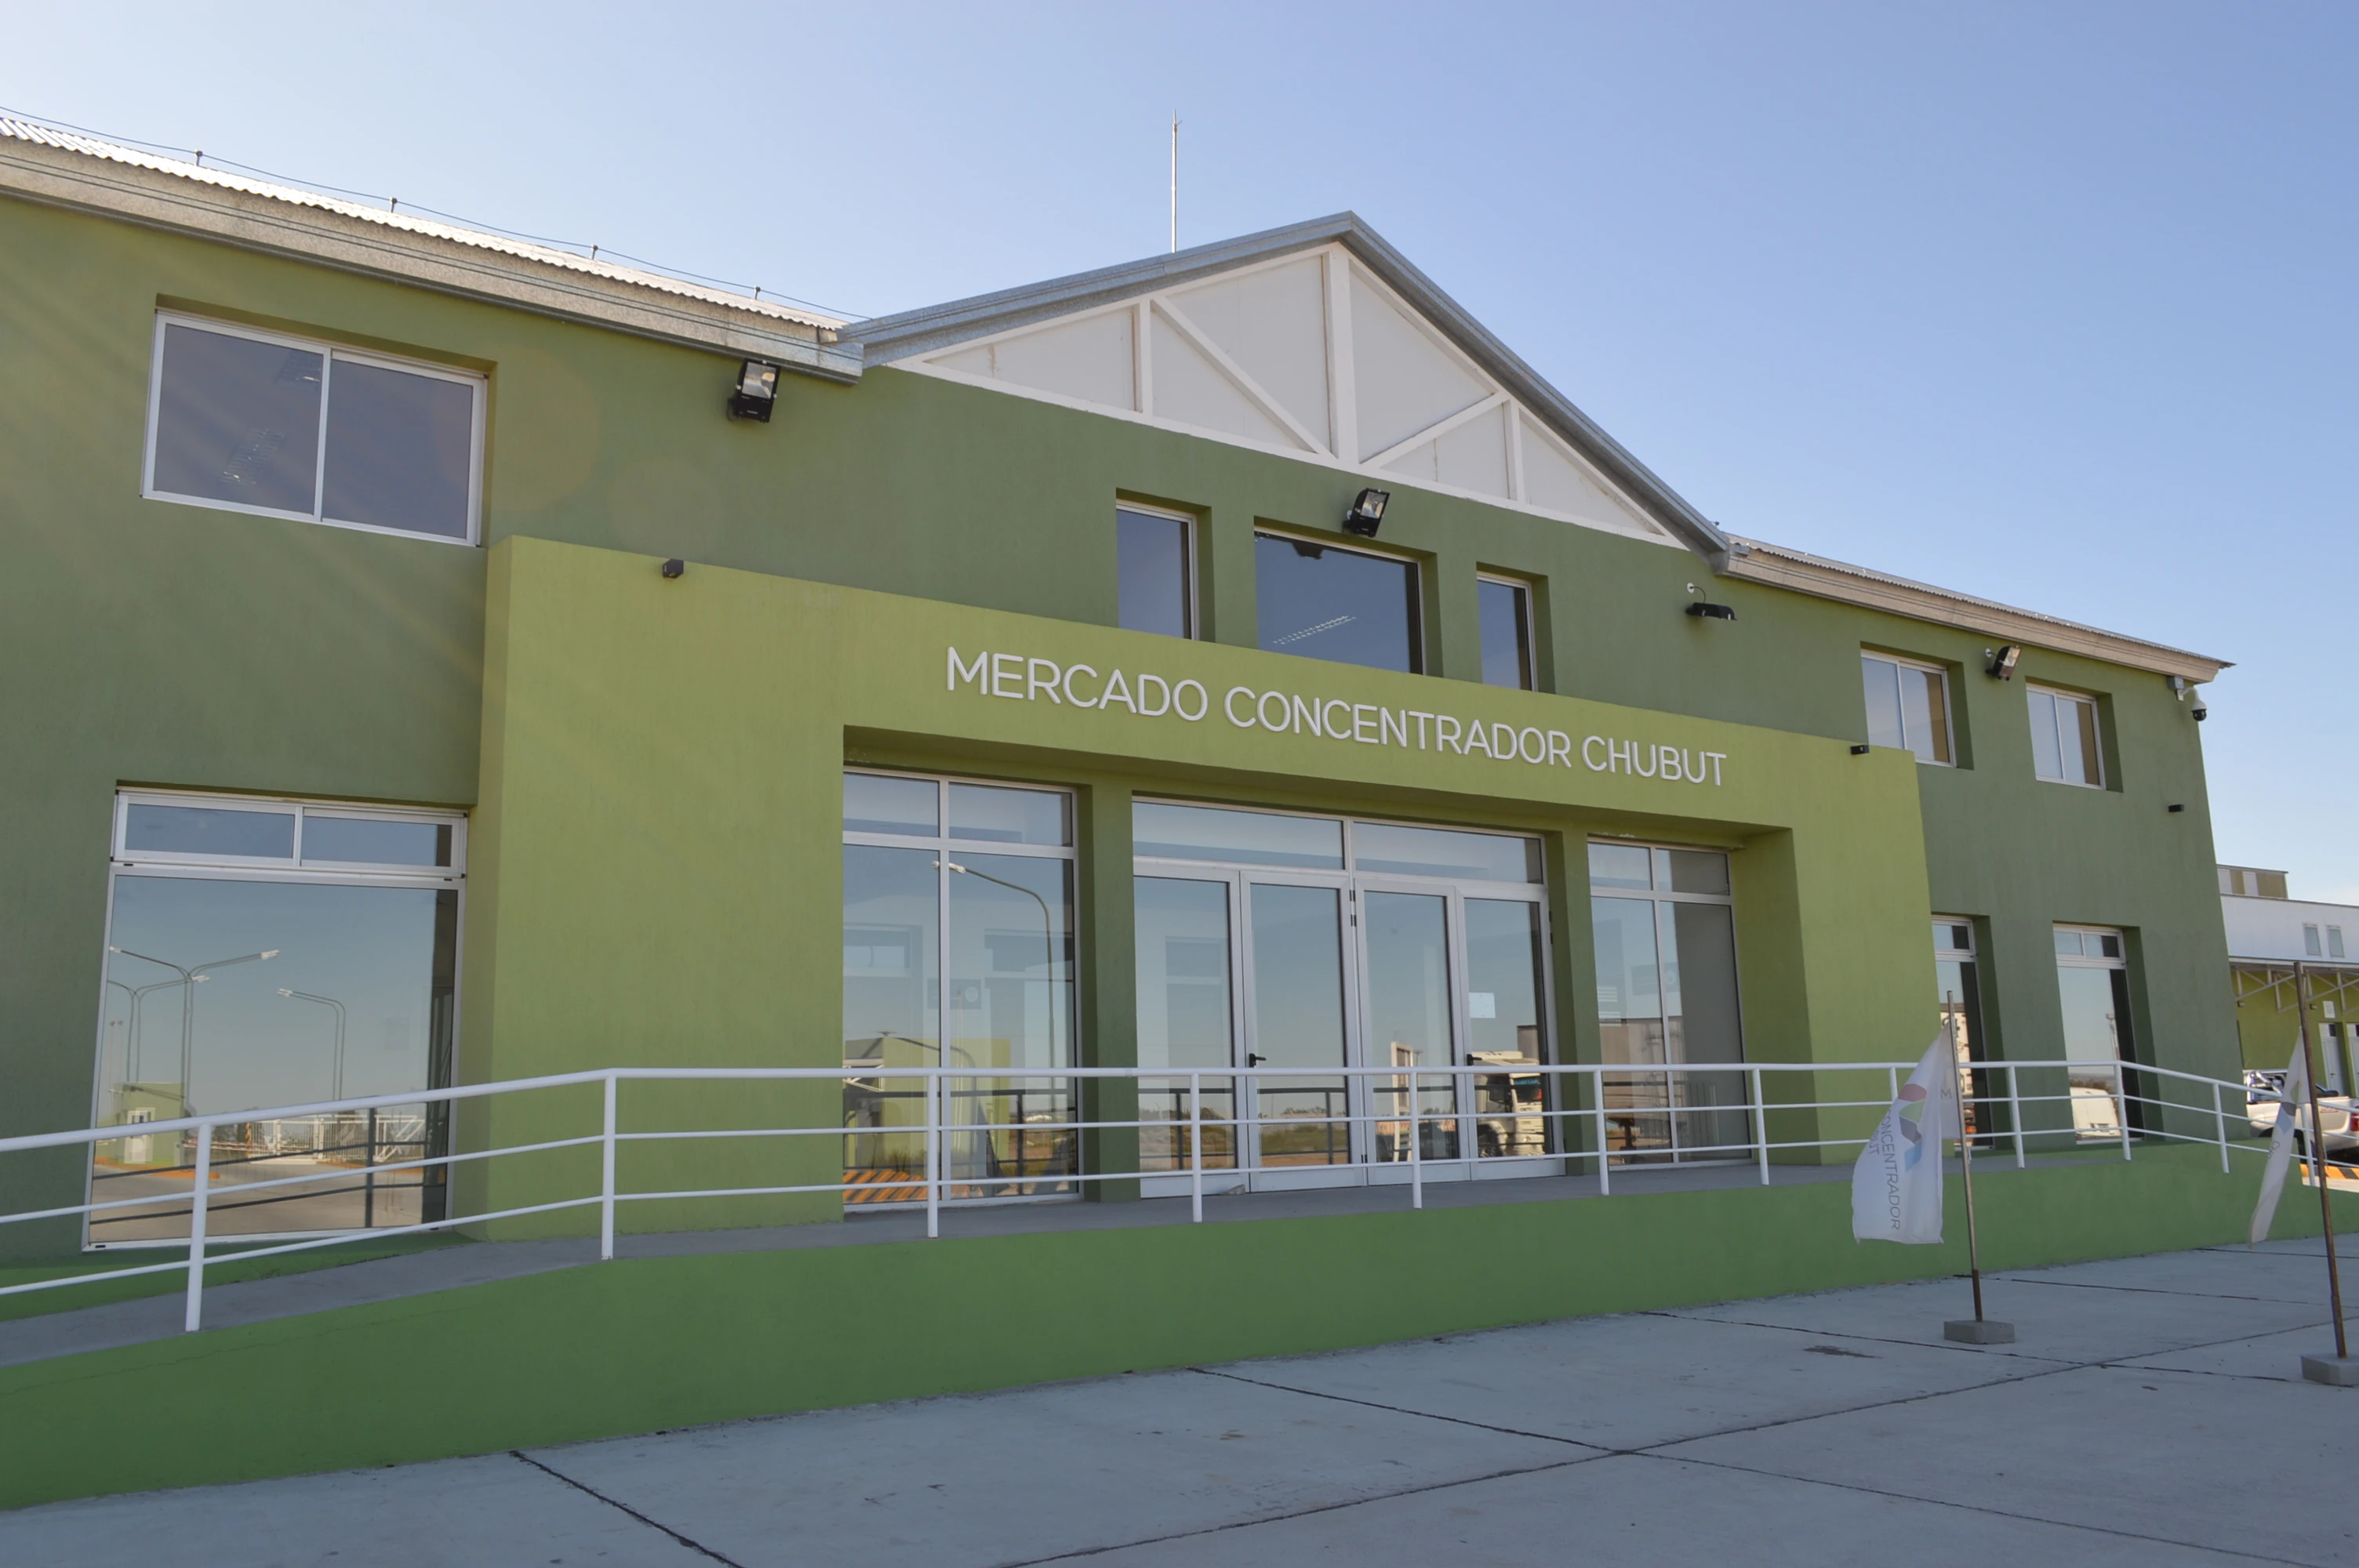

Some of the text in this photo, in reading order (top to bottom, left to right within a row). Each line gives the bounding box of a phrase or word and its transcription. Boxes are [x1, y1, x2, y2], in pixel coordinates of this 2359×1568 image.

[947, 646, 1727, 786] MERCADO CONCENTRADOR CHUBUT
